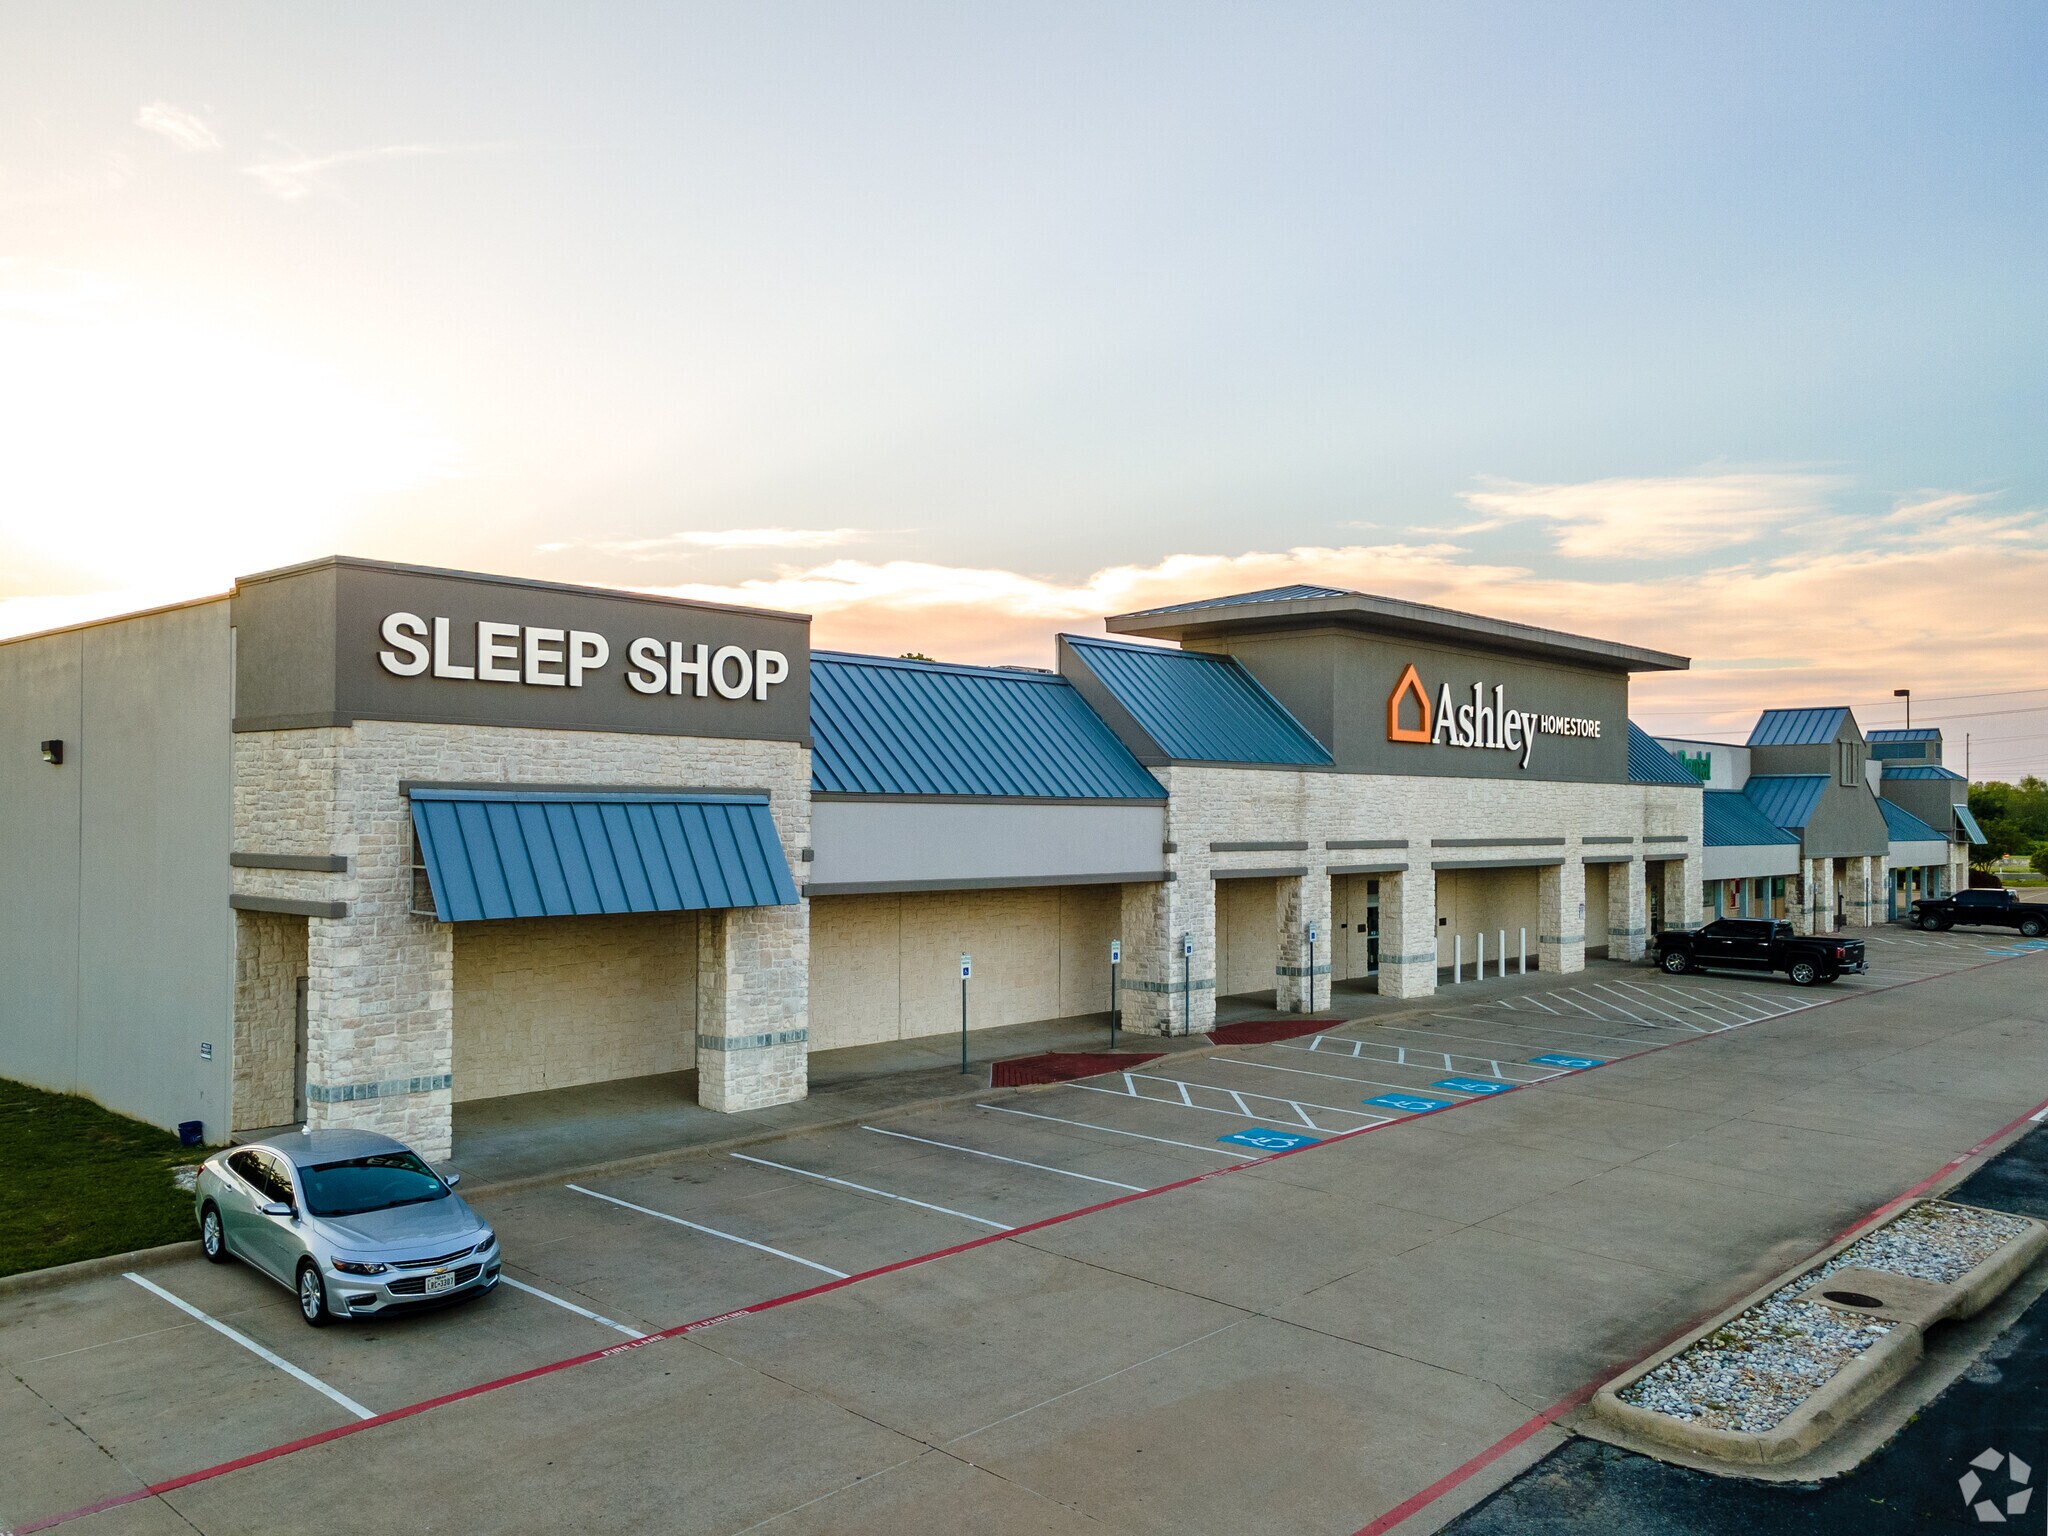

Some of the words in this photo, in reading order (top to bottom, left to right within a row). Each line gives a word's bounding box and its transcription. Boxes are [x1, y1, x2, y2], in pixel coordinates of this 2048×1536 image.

[377, 612, 610, 687] SLEEP
[624, 637, 789, 701] SHOP
[1431, 681, 1538, 769] Ashley
[1540, 714, 1601, 738] HOMESTORE
[601, 1344, 632, 1356] FIRE
[631, 1334, 667, 1347] LANE
[701, 1310, 750, 1326] PARKING
